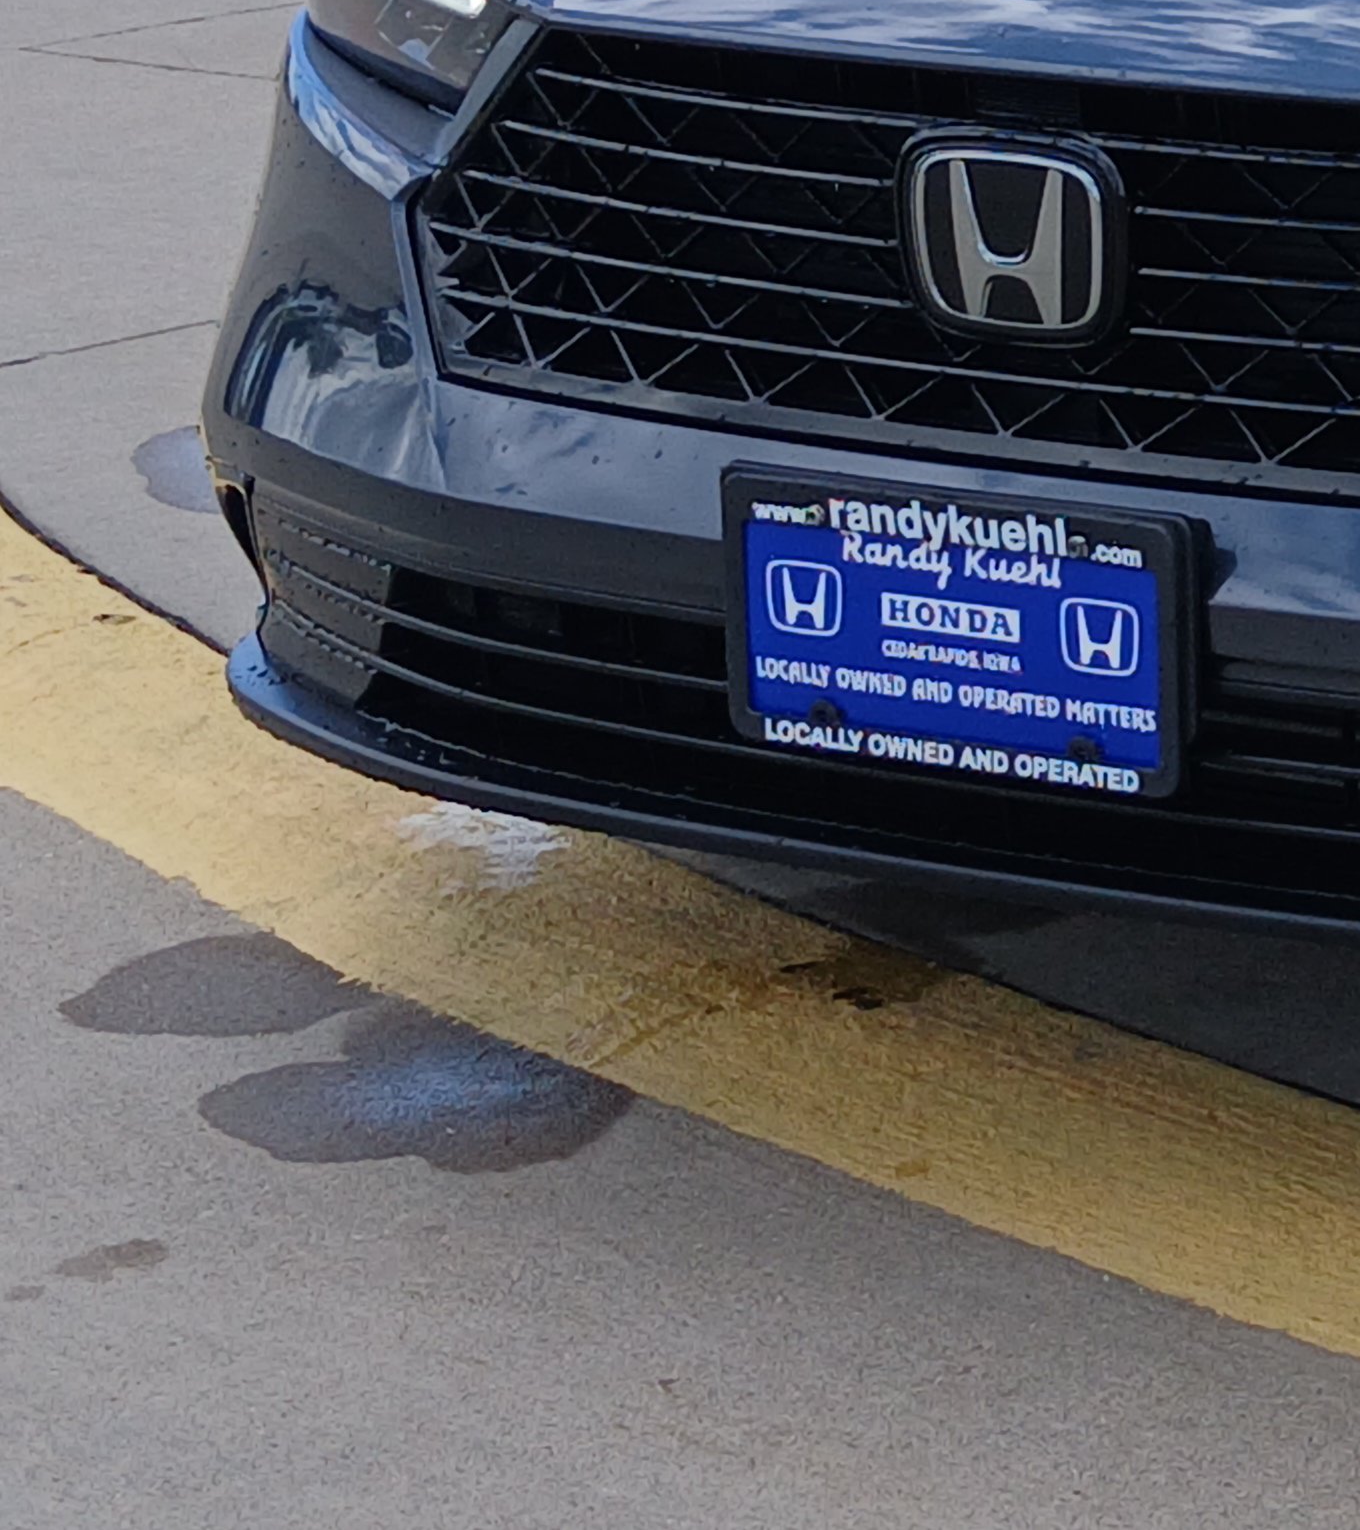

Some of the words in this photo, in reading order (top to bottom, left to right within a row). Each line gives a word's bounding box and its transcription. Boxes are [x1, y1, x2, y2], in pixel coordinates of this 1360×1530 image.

[828, 498, 1068, 557] randykuehl
[841, 530, 953, 590] Randy
[964, 548, 1062, 589] Kuehl
[889, 598, 1014, 636] HONDA
[756, 656, 831, 688] LOCALLY
[836, 668, 907, 697] OWNED
[912, 678, 953, 704] AND
[958, 685, 1060, 719] OPERATED
[1066, 698, 1157, 732] MATTERS
[765, 718, 864, 753] LOCALLY
[867, 733, 955, 766] OWNED
[959, 746, 1010, 774] AND
[1014, 754, 1141, 793] OPERATED
